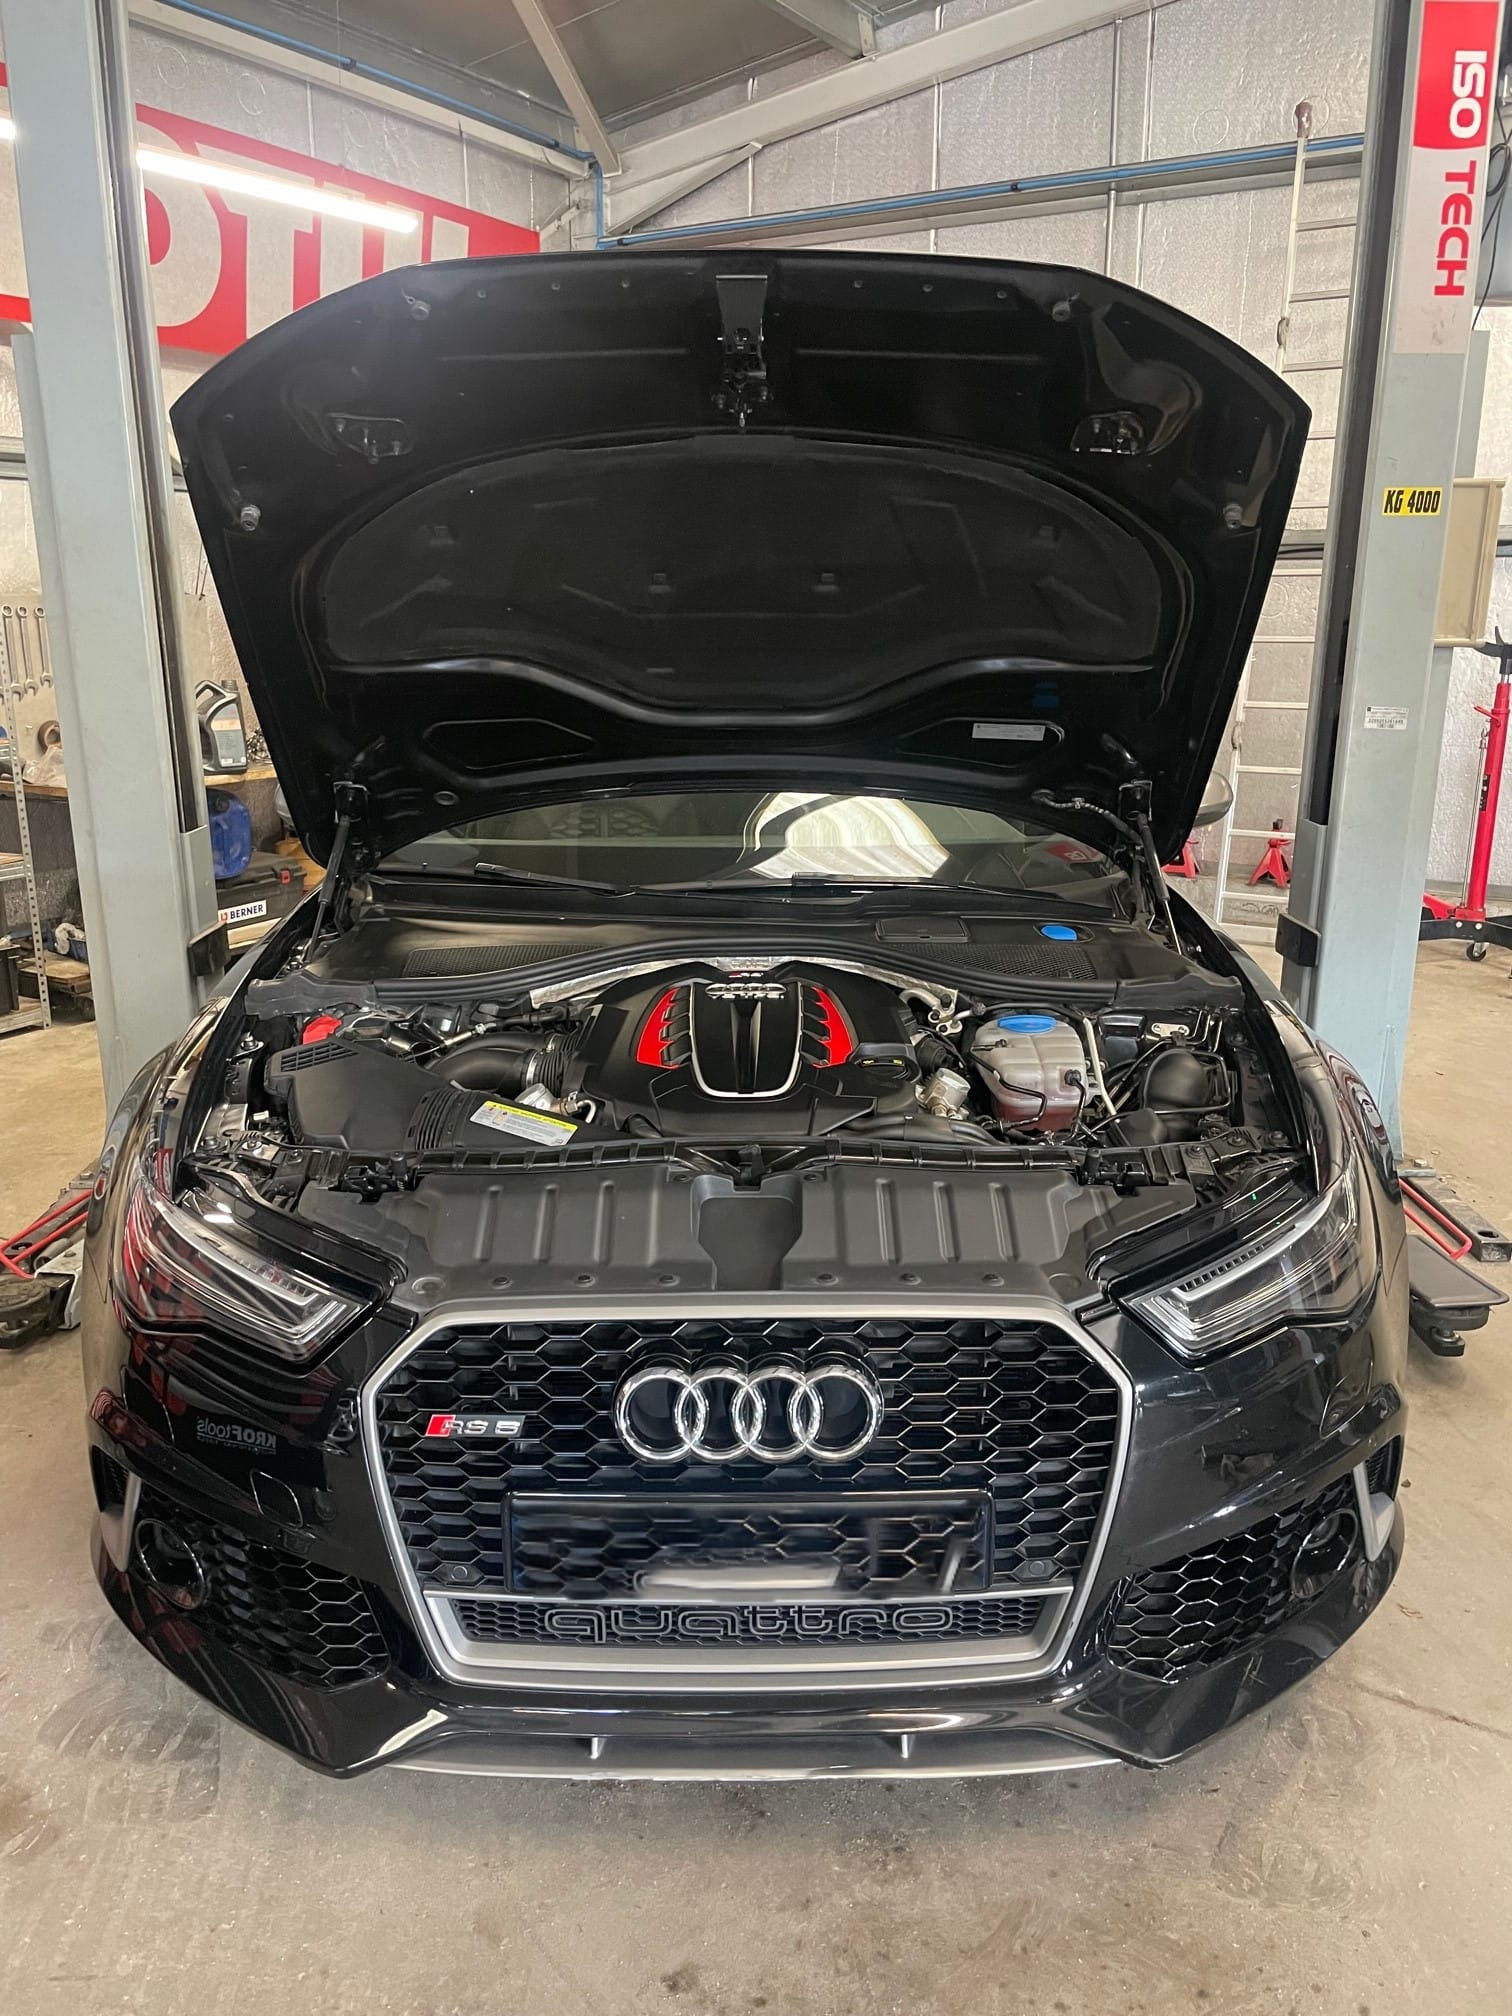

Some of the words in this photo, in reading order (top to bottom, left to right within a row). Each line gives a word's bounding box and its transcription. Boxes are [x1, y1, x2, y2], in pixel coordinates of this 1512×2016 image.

[1449, 50, 1488, 140] ISO
[1434, 160, 1477, 296] TECH
[1383, 490, 1405, 513] KG
[1407, 490, 1441, 513] 4000
[230, 904, 264, 920] BERNER
[441, 1418, 489, 1435] RS
[544, 1605, 953, 1644] quattro
